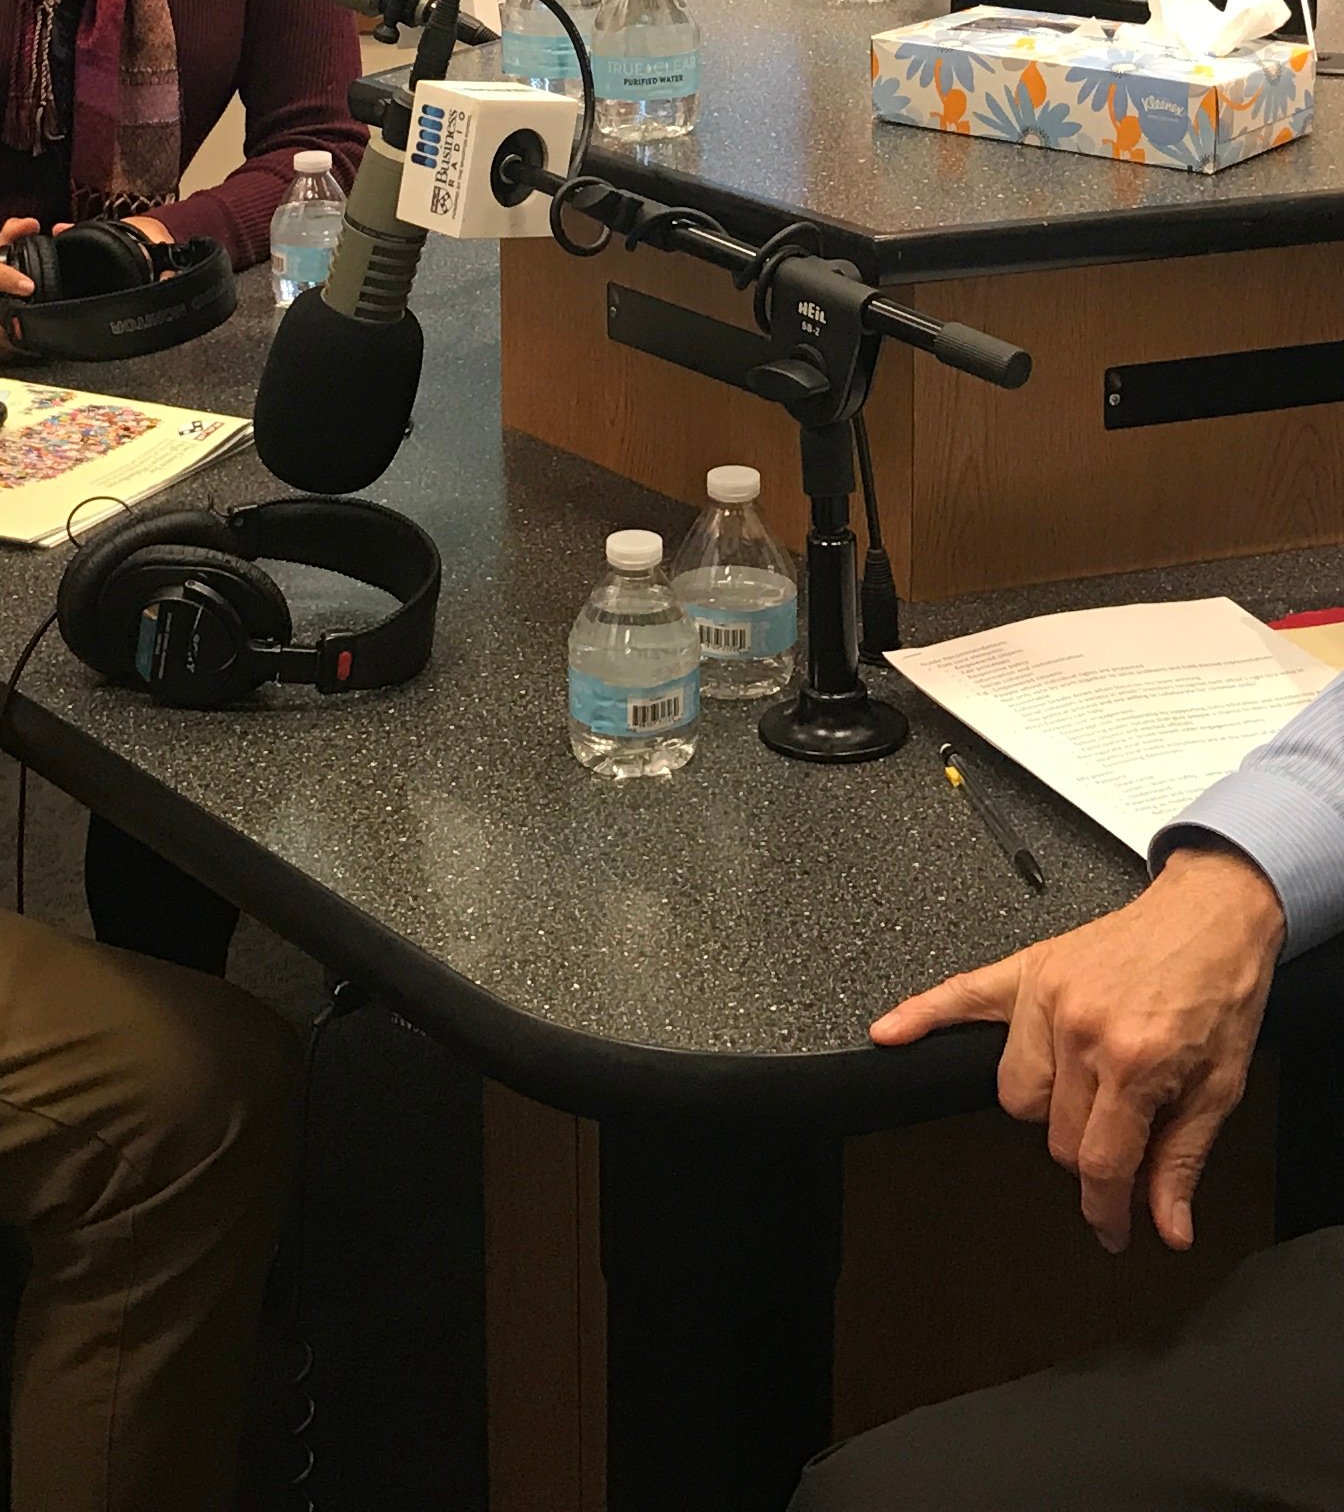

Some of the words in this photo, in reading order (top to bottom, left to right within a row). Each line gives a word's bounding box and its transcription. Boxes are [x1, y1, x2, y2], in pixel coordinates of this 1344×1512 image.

[623, 77, 658, 86] PURIFIED
[659, 74, 684, 84] WATER
[1141, 94, 1185, 118] Kleenex
[435, 108, 458, 185] Business
[447, 111, 466, 188] RADIO
